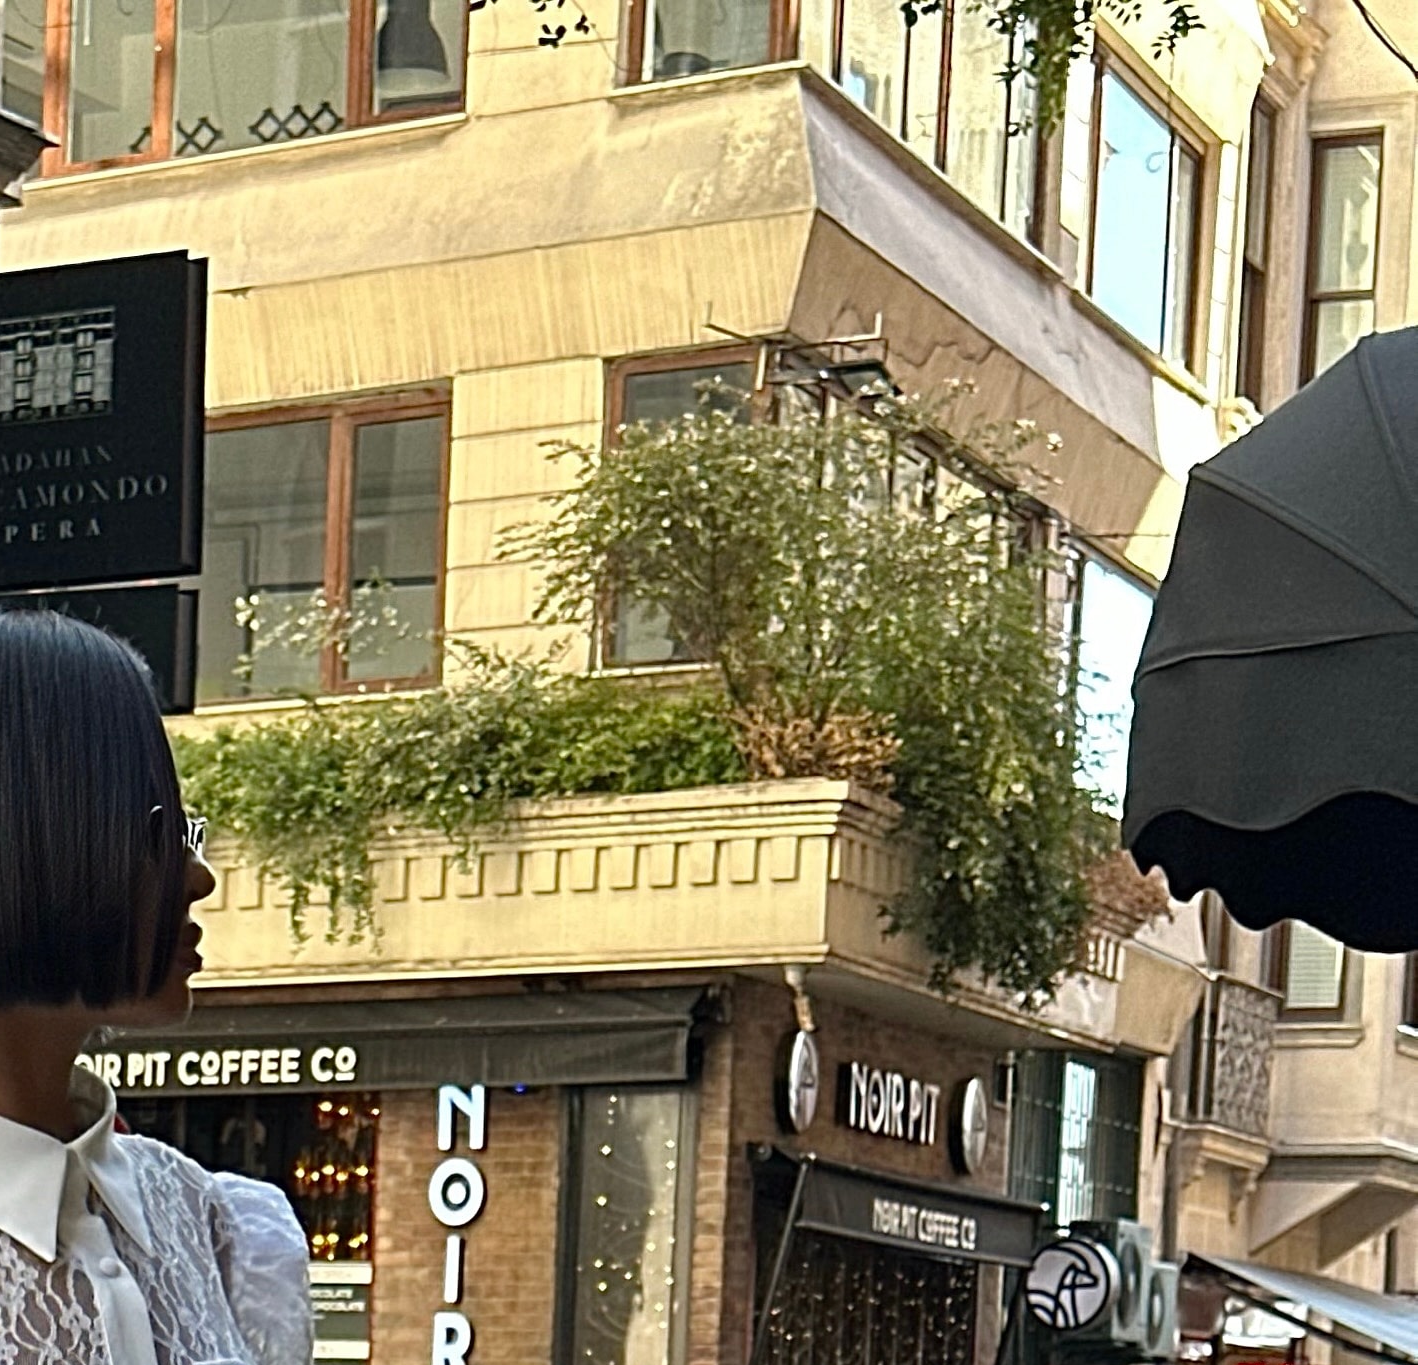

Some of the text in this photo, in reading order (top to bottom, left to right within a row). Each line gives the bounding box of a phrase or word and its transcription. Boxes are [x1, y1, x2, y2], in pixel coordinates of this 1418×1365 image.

[4, 517, 102, 545] PERA
[127, 1051, 172, 1087] PIT
[177, 1049, 302, 1086] COFFEE
[310, 1046, 357, 1082] CO
[848, 1060, 942, 1146] NOIR PIT
[872, 1197, 901, 1237] NOIR
